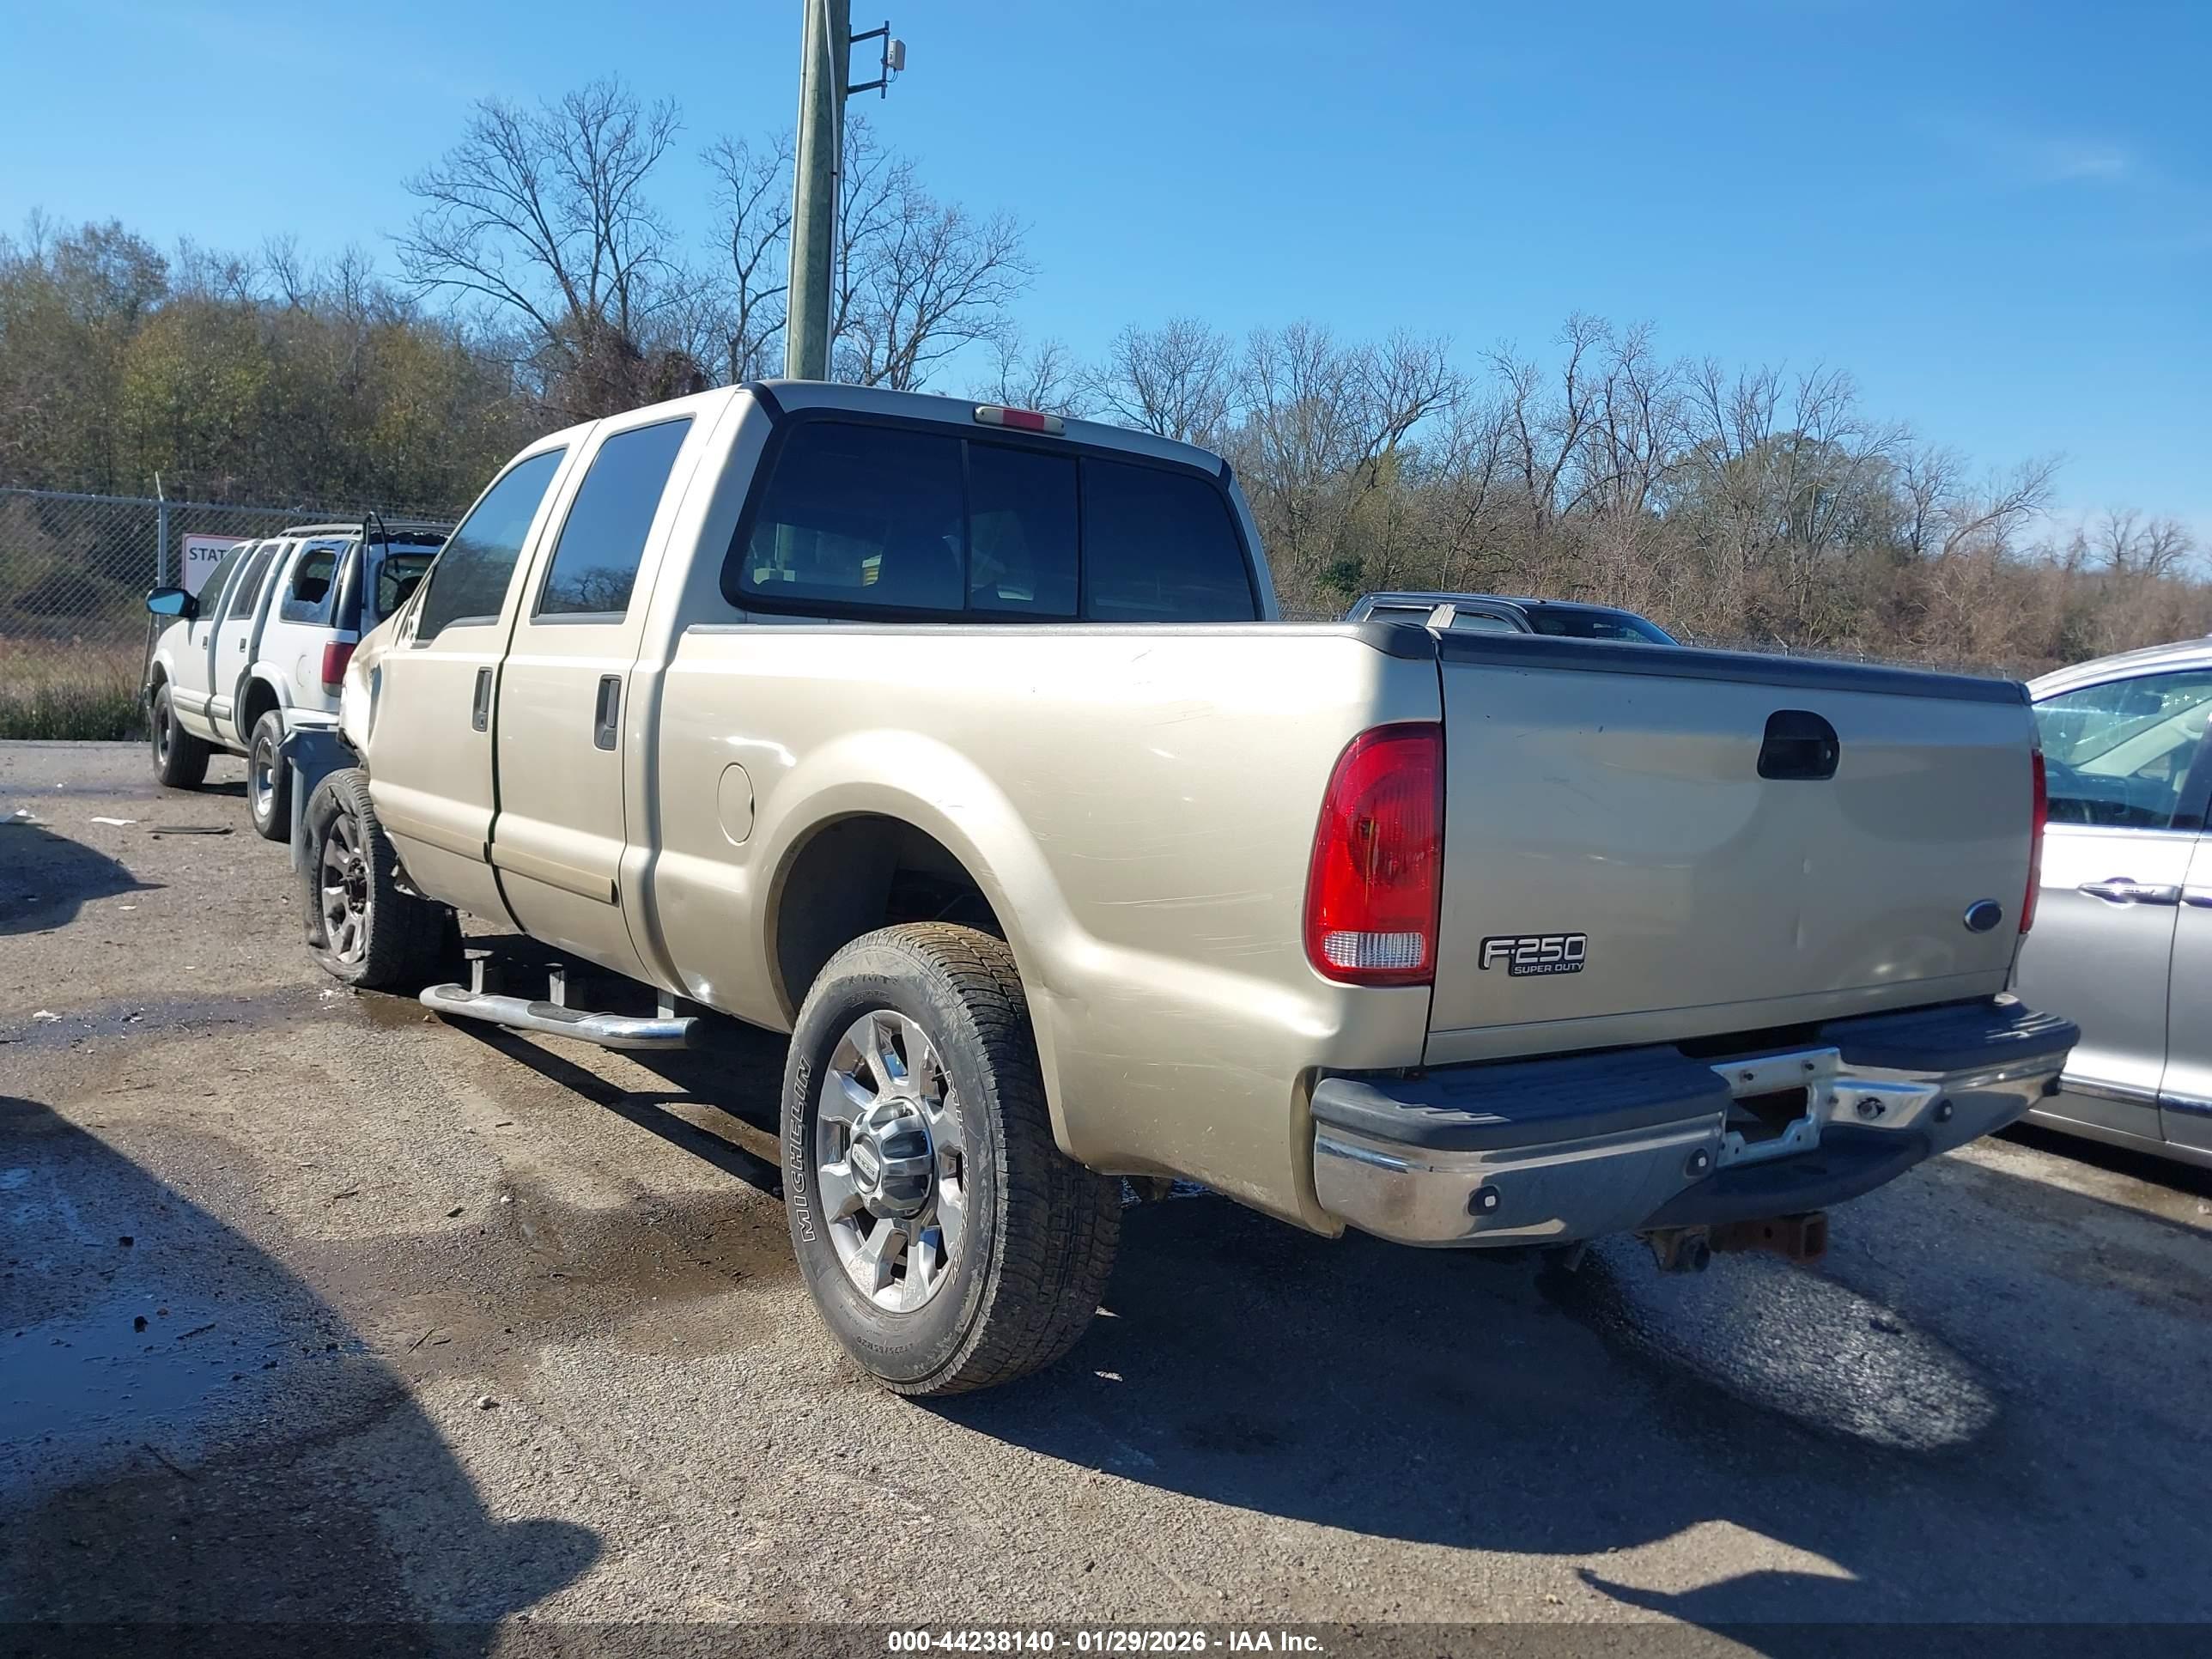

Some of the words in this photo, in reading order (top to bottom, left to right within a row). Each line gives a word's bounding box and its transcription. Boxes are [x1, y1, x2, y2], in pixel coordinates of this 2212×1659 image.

[1514, 964, 1552, 975] SUPER
[1554, 963, 1584, 972] DUTY
[790, 1055, 817, 1243] MICHELIN
